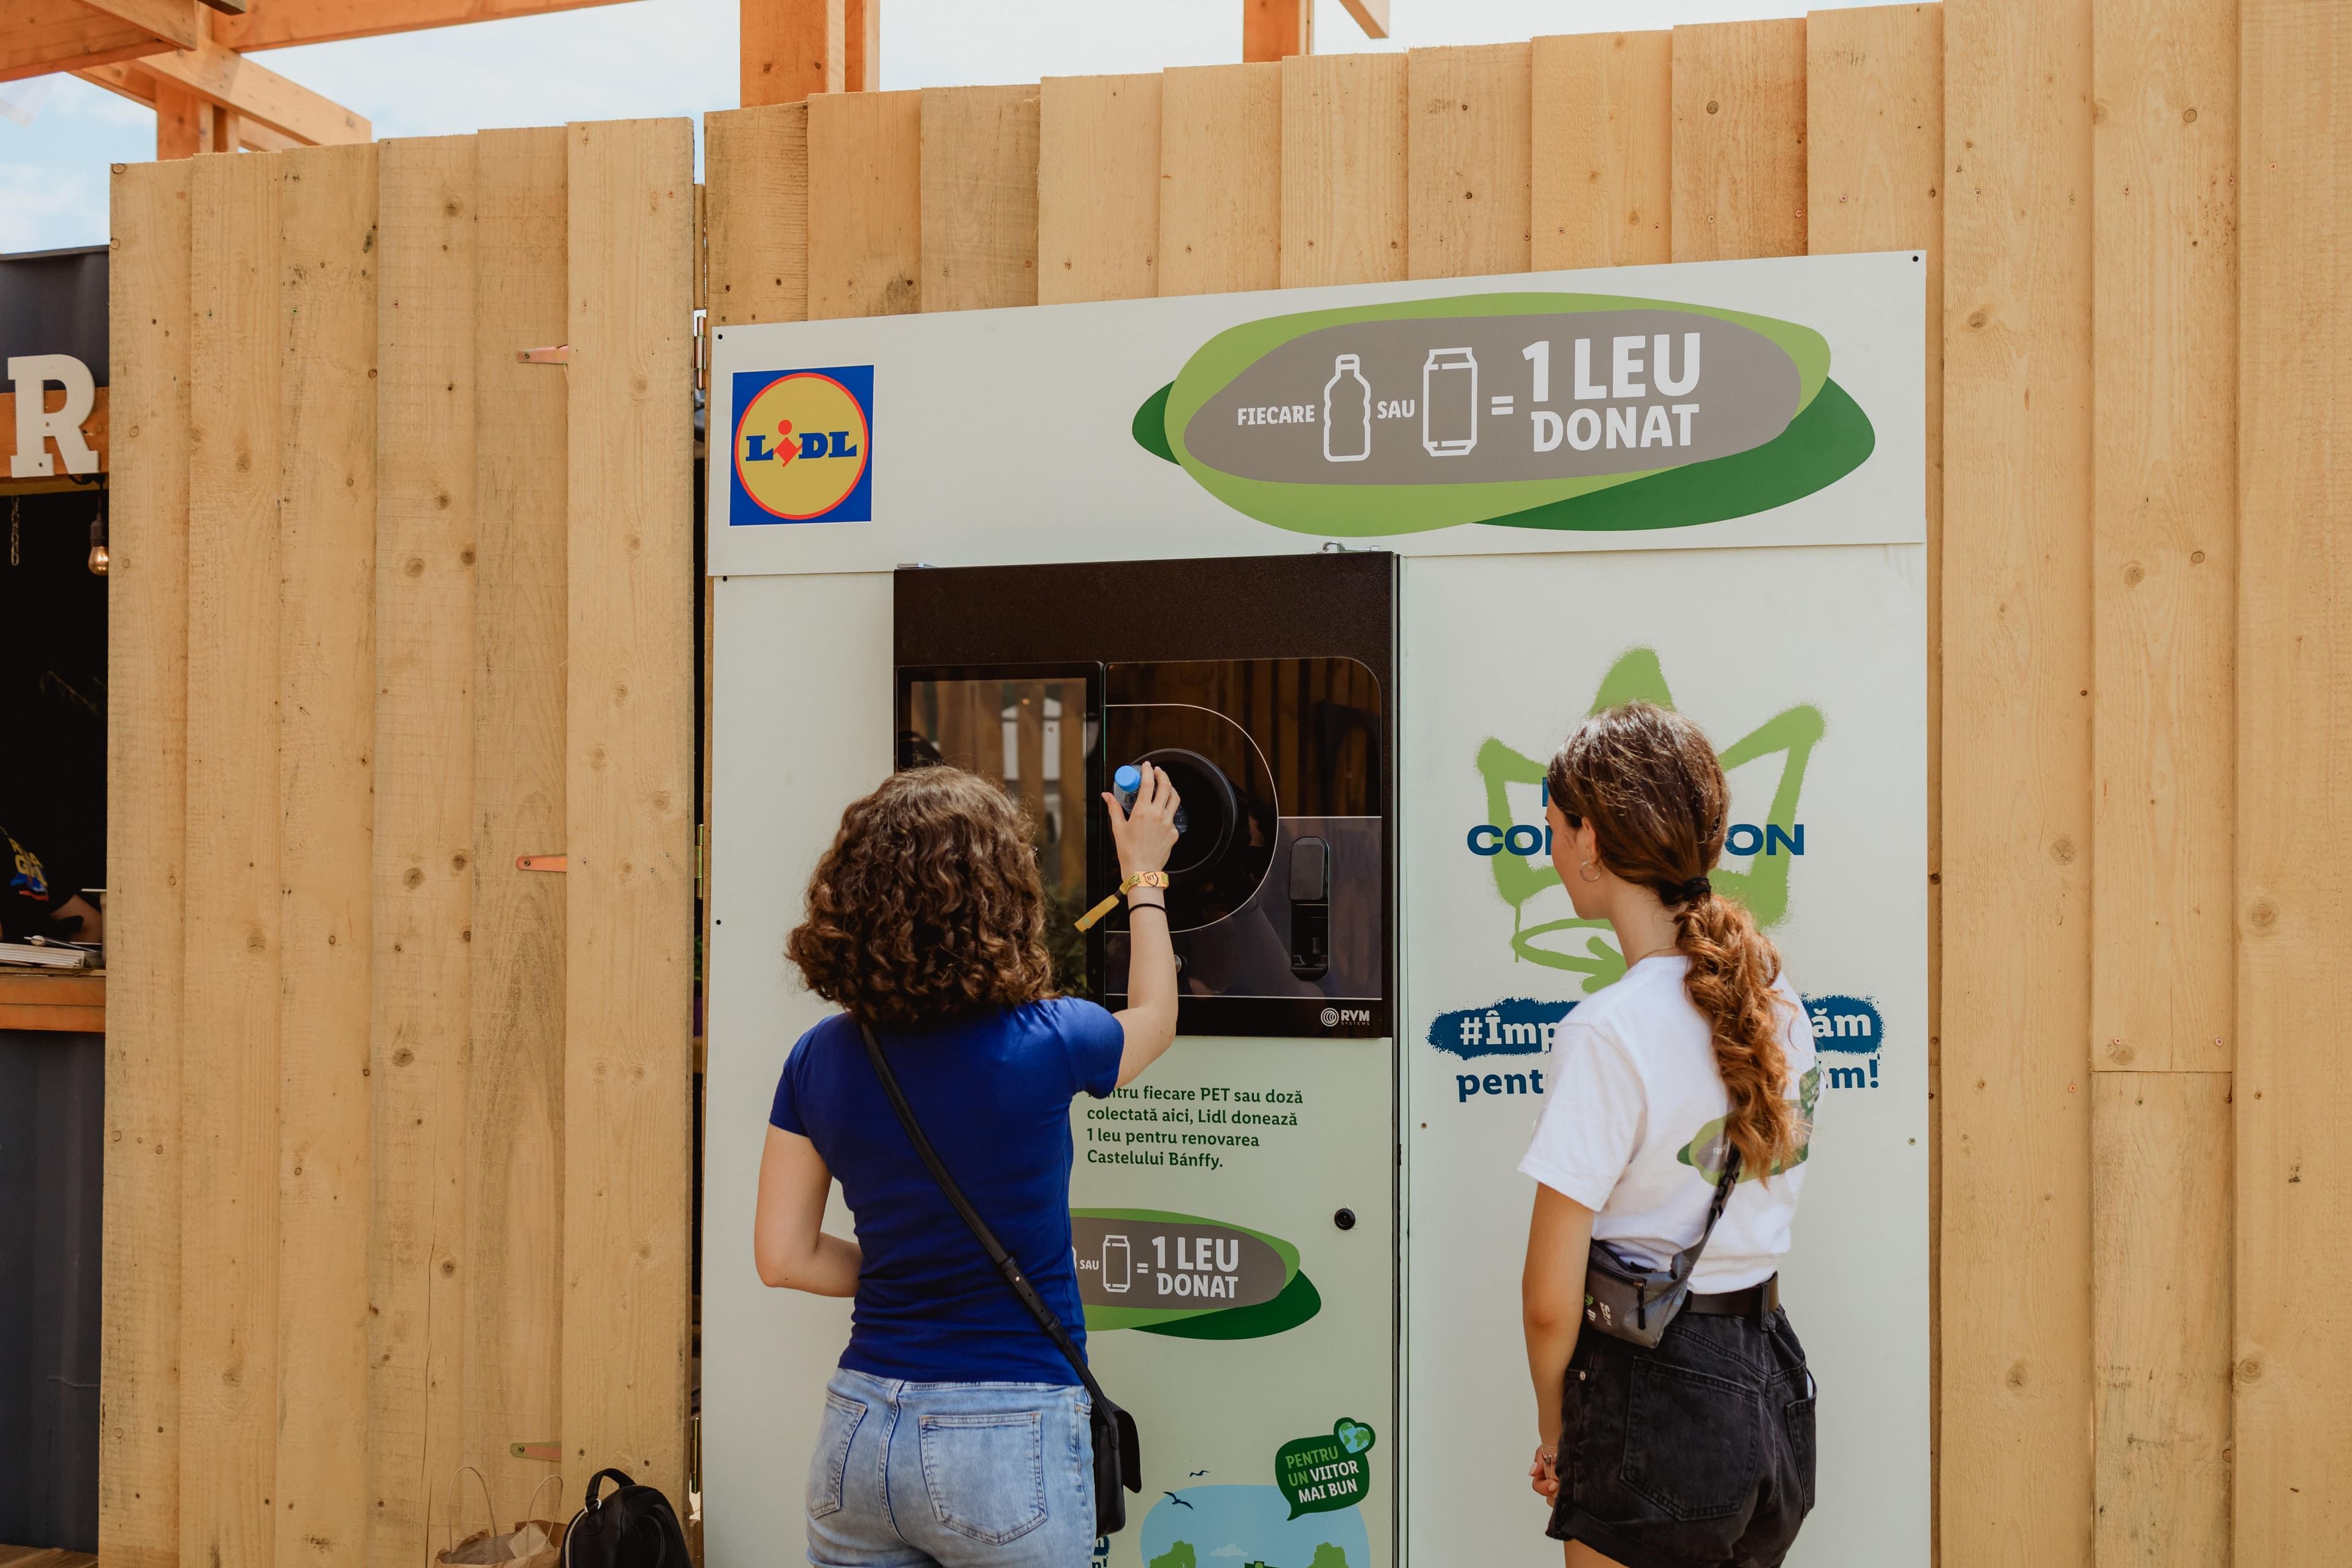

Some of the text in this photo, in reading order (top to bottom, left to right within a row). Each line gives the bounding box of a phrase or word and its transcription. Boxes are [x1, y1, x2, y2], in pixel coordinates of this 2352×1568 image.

[1238, 405, 1315, 425] FIECARE
[1377, 399, 1415, 419] SAU
[1522, 341, 1549, 402] 1
[1575, 333, 1700, 400] LEU
[8, 354, 99, 478] R
[1531, 404, 1700, 452] DONAT
[1341, 1010, 1370, 1021] RVM
[1460, 1008, 1872, 1051] #Împ ăm
[1456, 1059, 1879, 1102] pent m!
[1144, 1086, 1195, 1100] fiecare
[1200, 1088, 1230, 1101] PET
[1234, 1091, 1261, 1102] sau
[1265, 1089, 1303, 1104] doză
[1087, 1106, 1298, 1126] colectată aici, Lidl donează
[1087, 1128, 1259, 1147] 1 leu pentru renovarea
[1087, 1150, 1223, 1170] Castelului Bánffy.
[1080, 1260, 1099, 1270] SAU
[1152, 1236, 1166, 1268] 1
[1177, 1237, 1238, 1272] LEU
[1156, 1273, 1238, 1298] DONAT
[1285, 1446, 1338, 1469] PENTRU
[1287, 1460, 1359, 1487] UN VIITOR
[1298, 1479, 1358, 1503] MAI BUN
